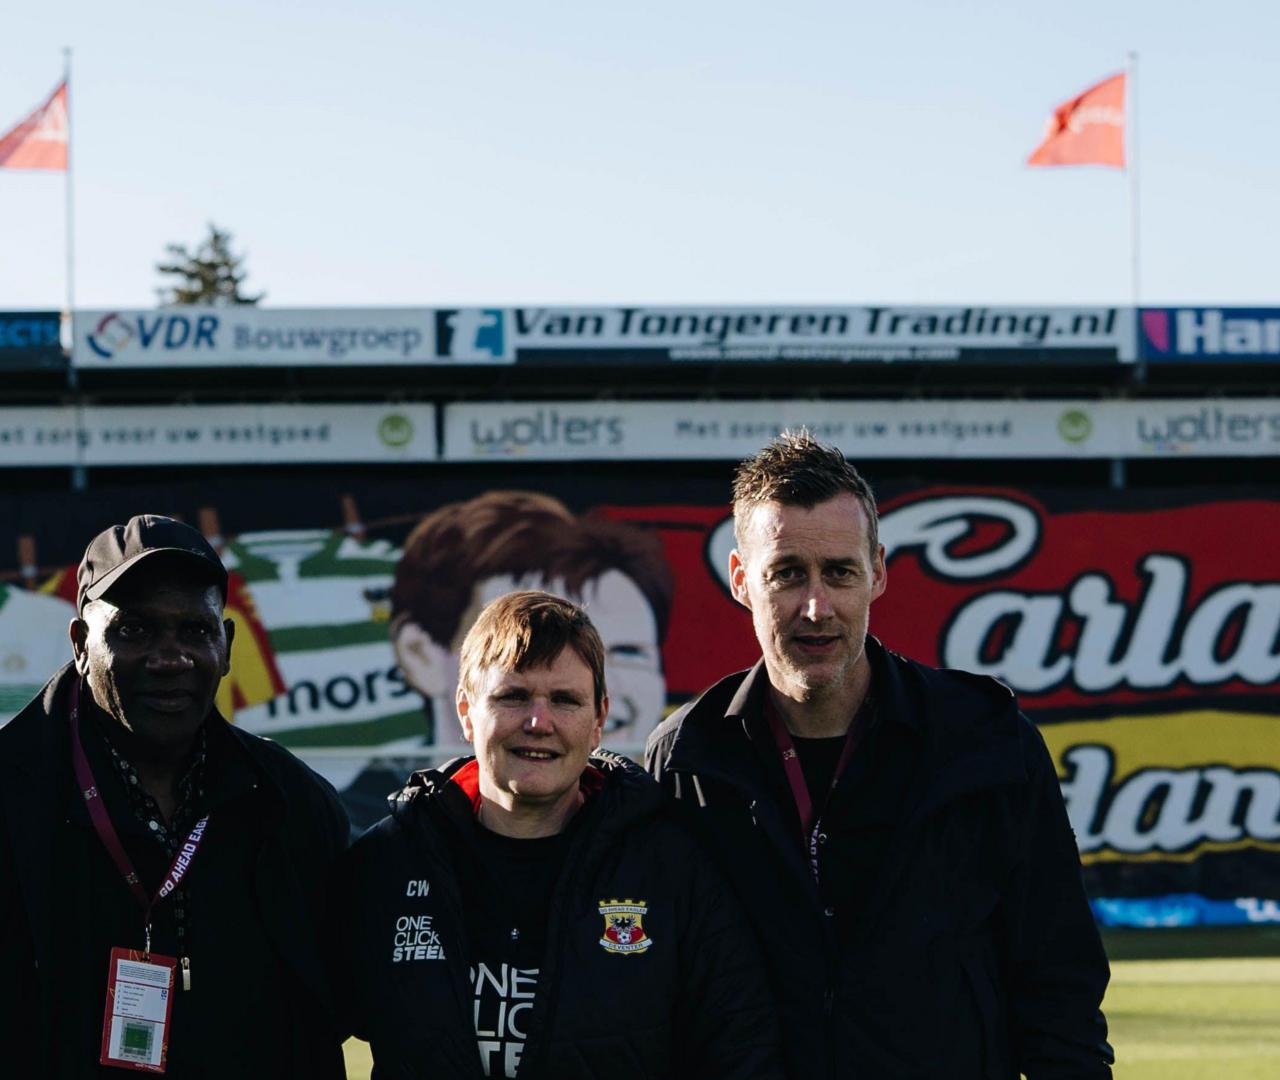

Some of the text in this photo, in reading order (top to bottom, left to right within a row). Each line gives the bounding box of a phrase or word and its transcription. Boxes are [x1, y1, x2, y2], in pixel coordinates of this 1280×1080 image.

[136, 316, 422, 356] VDR Bouwgroep
[514, 308, 1117, 345] Van Tongeren Trading.nl
[470, 409, 625, 446] wolters
[159, 879, 175, 898] GO
[171, 843, 197, 882] AHEAD
[406, 879, 430, 898] CW
[393, 930, 442, 947] CLICK
[395, 915, 434, 932] ONE
[392, 944, 447, 963] STEEL
[470, 962, 540, 1000] NE
